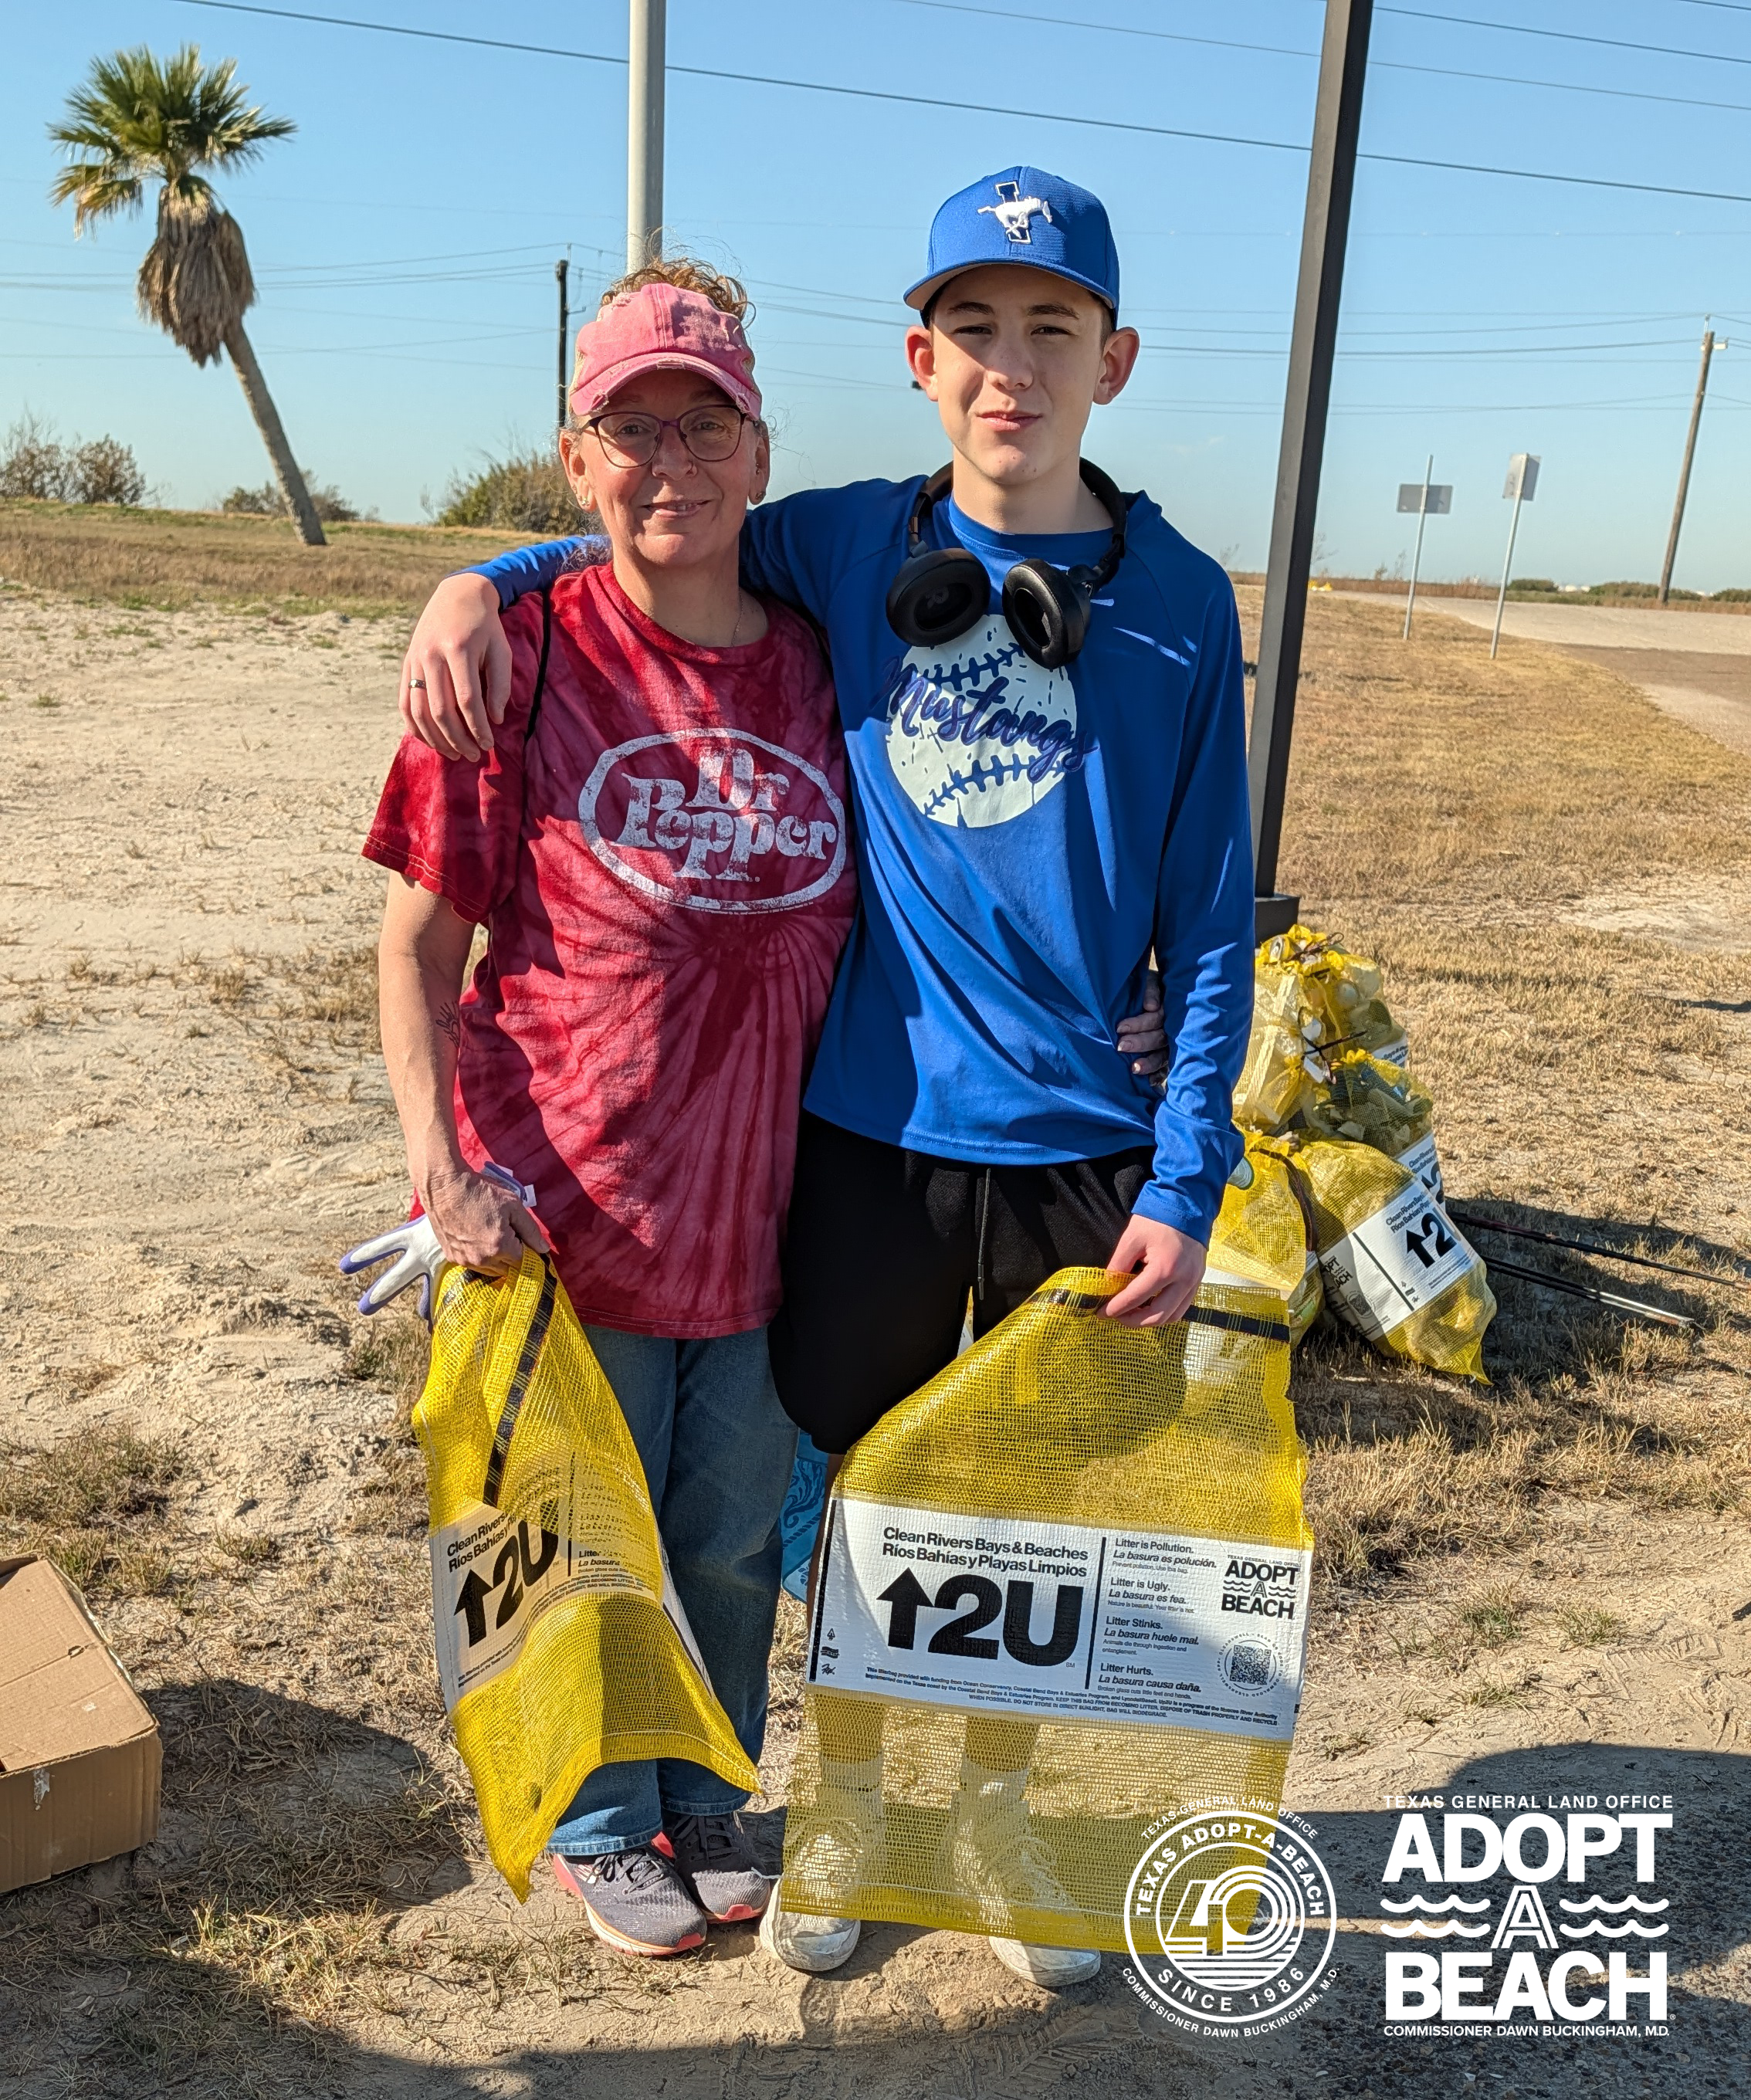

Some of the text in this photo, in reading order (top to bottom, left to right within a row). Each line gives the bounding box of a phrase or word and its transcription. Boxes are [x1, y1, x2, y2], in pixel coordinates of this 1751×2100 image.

[868, 656, 1099, 782] Mustangs
[686, 747, 790, 811] Dr
[609, 773, 837, 882] Pepper
[447, 1533, 477, 1556] Clean
[478, 1512, 506, 1539] Rivers
[883, 1526, 1088, 1560] Clean Rivers Bays & Beaches
[1115, 1538, 1194, 1553] Litter is Pollution.
[449, 1552, 473, 1573] Ríos
[473, 1529, 505, 1558] Bahías
[882, 1543, 1087, 1577] Ríos Bahías y Playas Limpios
[1113, 1550, 1125, 1558] La
[1127, 1551, 1159, 1562] basura
[1174, 1556, 1217, 1568] polución.
[1111, 1577, 1170, 1592] Litter is Ugly.
[1224, 1560, 1300, 1585] ADOPT
[1109, 1589, 1120, 1597] La
[1122, 1590, 1154, 1601] basura
[1170, 1594, 1187, 1604] fea.
[1251, 1581, 1267, 1598] A
[1221, 1594, 1295, 1620] BEACH
[928, 1574, 1084, 1667] 2U
[1106, 1616, 1163, 1630] Litter Stinks.
[1104, 1628, 1199, 1645] La basura huele mal.
[1100, 1662, 1153, 1676] Litter Hurts.
[1098, 1675, 1201, 1692] La basura causa daña.
